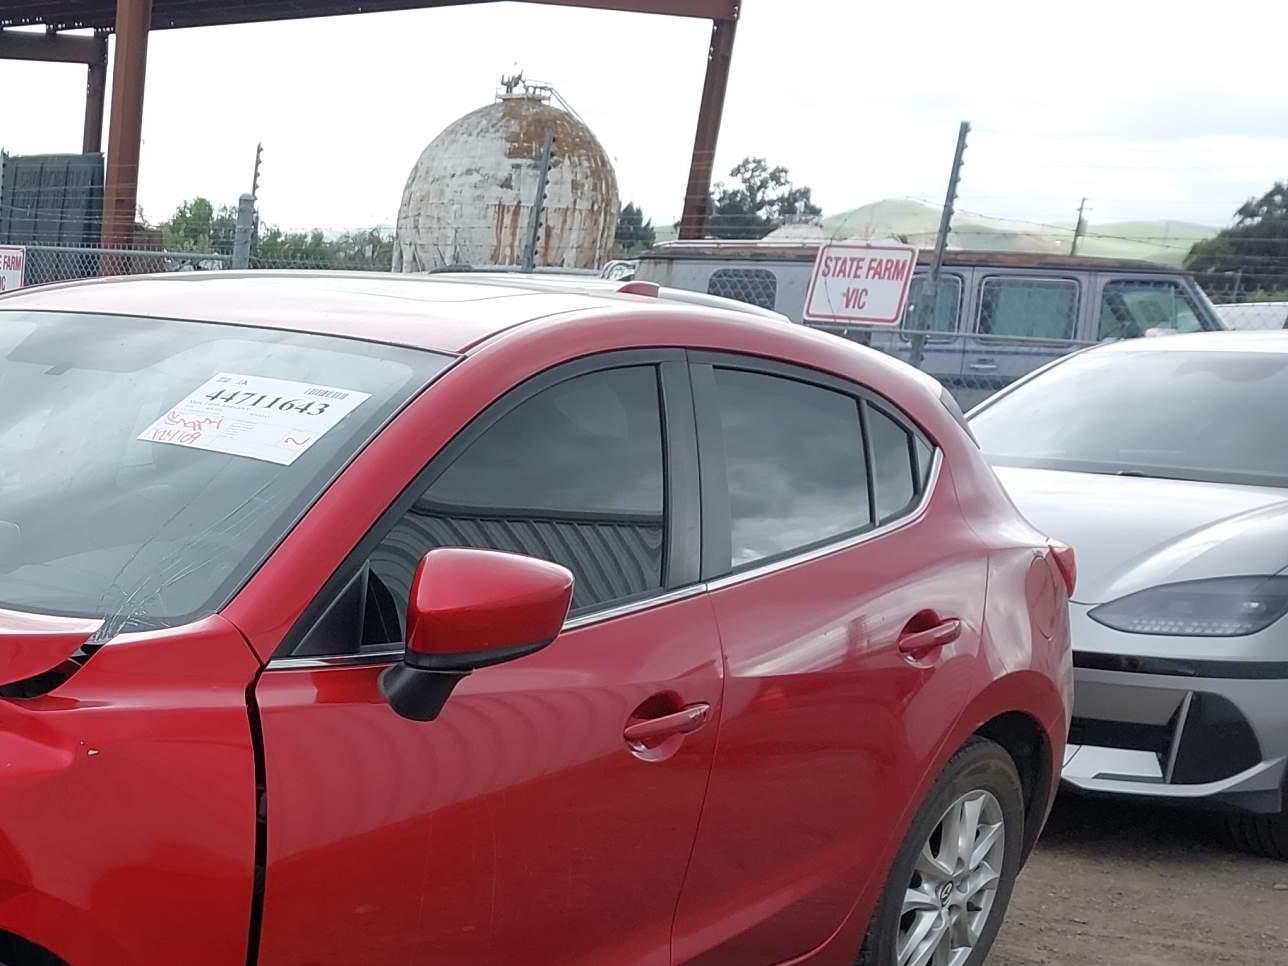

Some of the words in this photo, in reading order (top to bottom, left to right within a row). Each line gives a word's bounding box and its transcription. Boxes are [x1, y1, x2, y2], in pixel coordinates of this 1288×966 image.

[3, 255, 22, 271] FARM
[821, 255, 865, 279] STATE
[865, 257, 908, 281] FARM
[844, 286, 868, 310] VIC
[205, 388, 330, 416] 44711643
